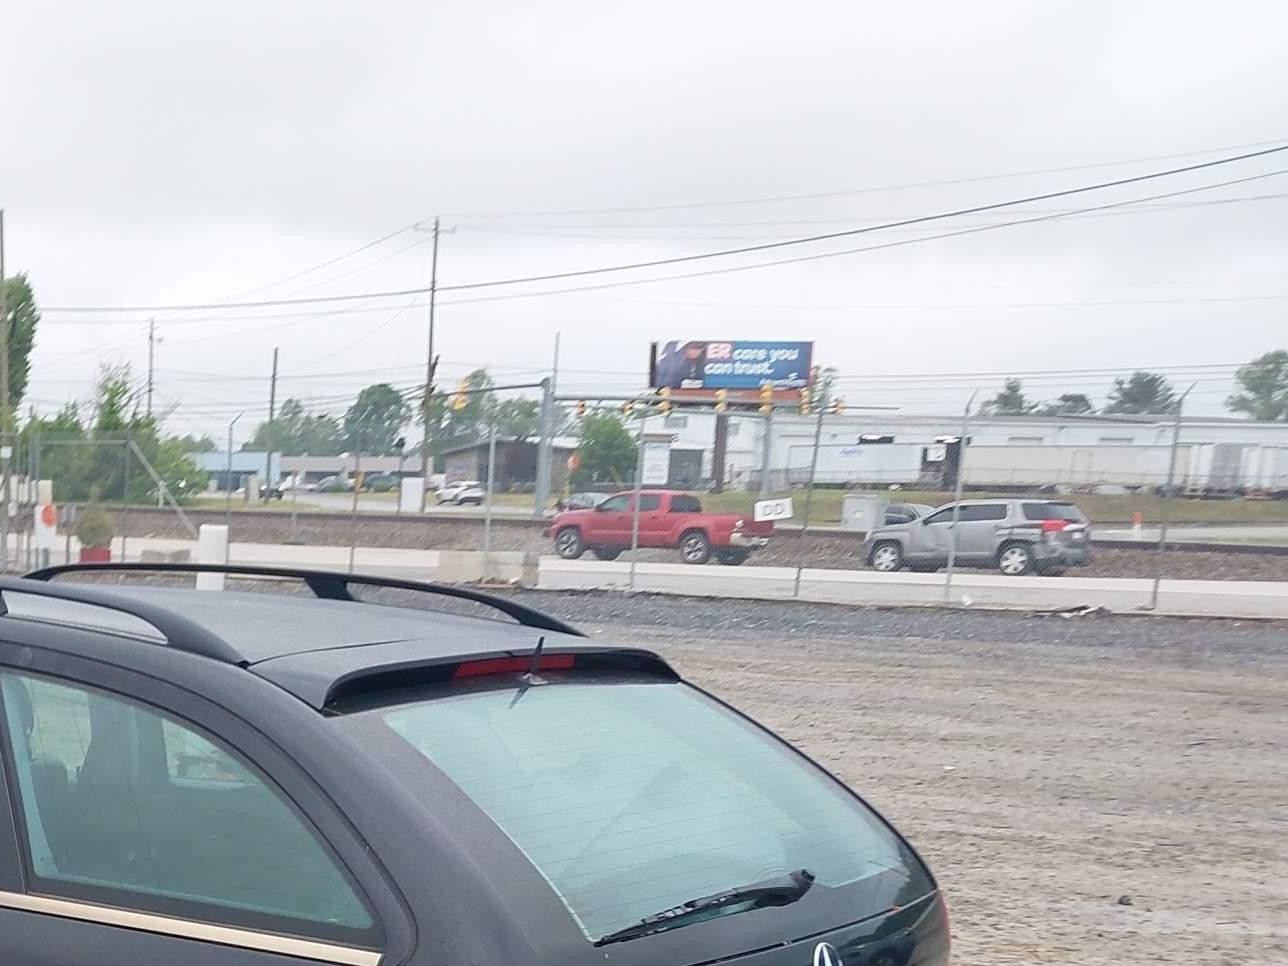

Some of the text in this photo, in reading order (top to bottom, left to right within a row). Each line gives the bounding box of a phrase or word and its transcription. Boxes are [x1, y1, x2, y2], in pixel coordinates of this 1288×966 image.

[706, 342, 799, 362] ER care you
[704, 362, 732, 375] can
